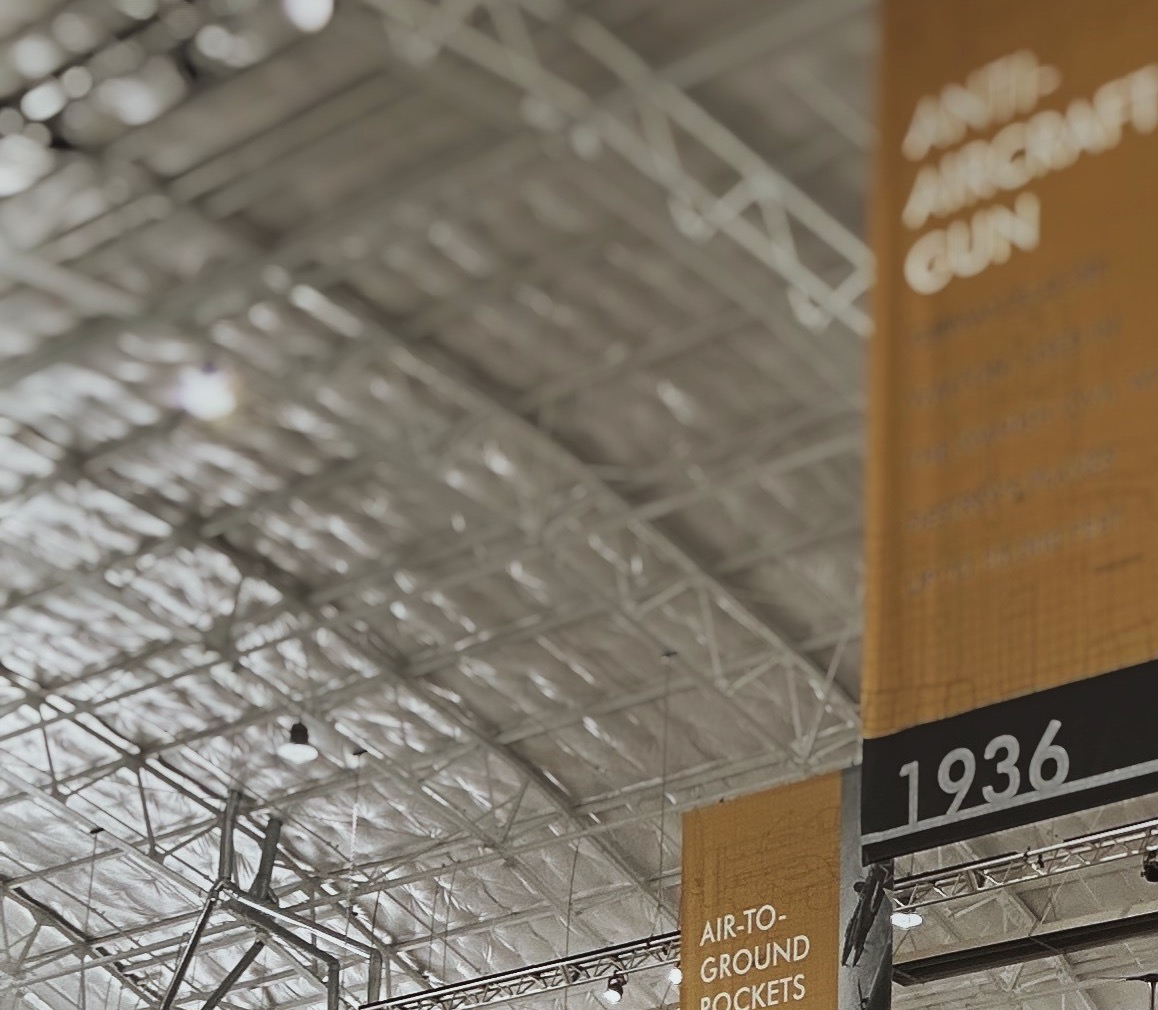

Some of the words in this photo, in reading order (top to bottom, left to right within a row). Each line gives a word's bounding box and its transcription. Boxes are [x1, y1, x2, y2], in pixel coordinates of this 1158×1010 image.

[904, 192, 1041, 295] GUN
[899, 719, 1070, 828] 1936
[699, 904, 788, 947] AIR-TO-
[700, 934, 810, 984] GROUND
